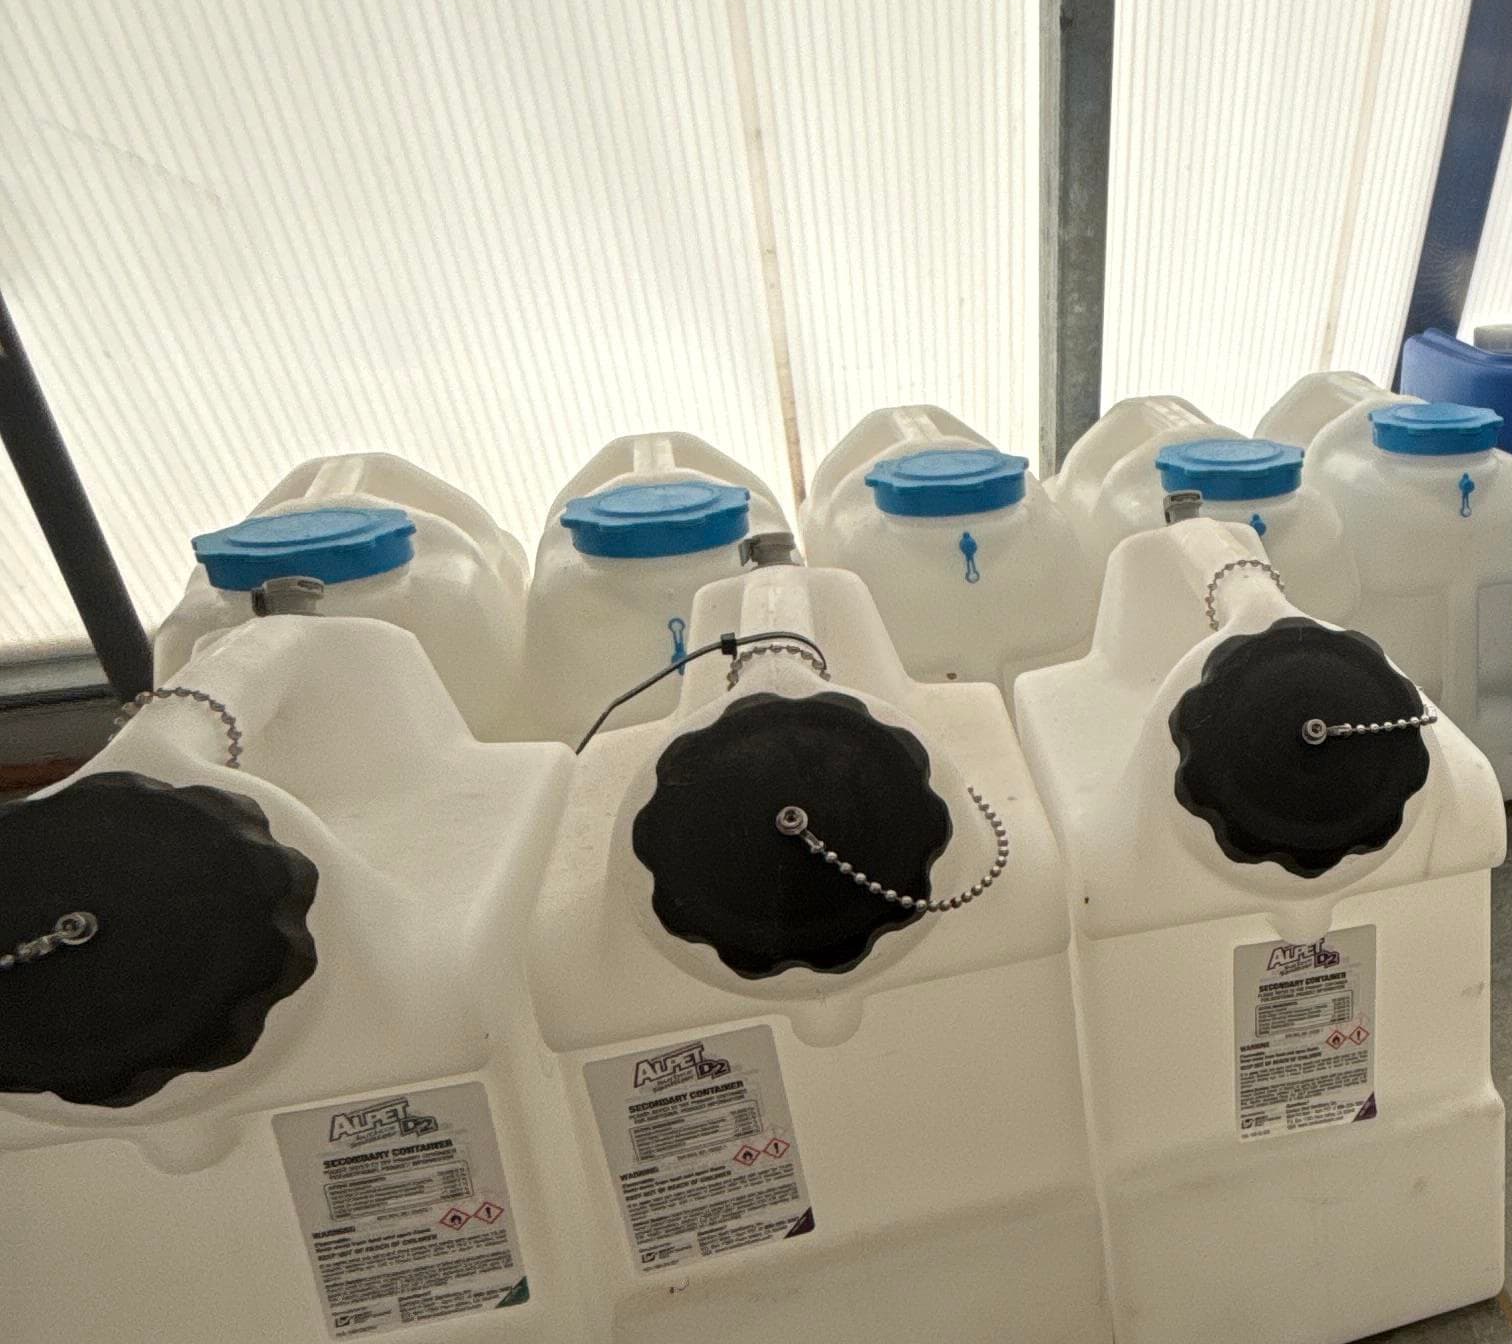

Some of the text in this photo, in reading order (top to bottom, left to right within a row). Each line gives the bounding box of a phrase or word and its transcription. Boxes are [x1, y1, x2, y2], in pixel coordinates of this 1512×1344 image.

[1267, 937, 1325, 971] ALPET
[1314, 950, 1340, 968] D2
[634, 1041, 704, 1088] ALPET
[697, 1058, 731, 1079] D2
[329, 1097, 409, 1142] ALPET
[400, 1115, 439, 1137] D2
[628, 1092, 688, 1114] SECONDARY
